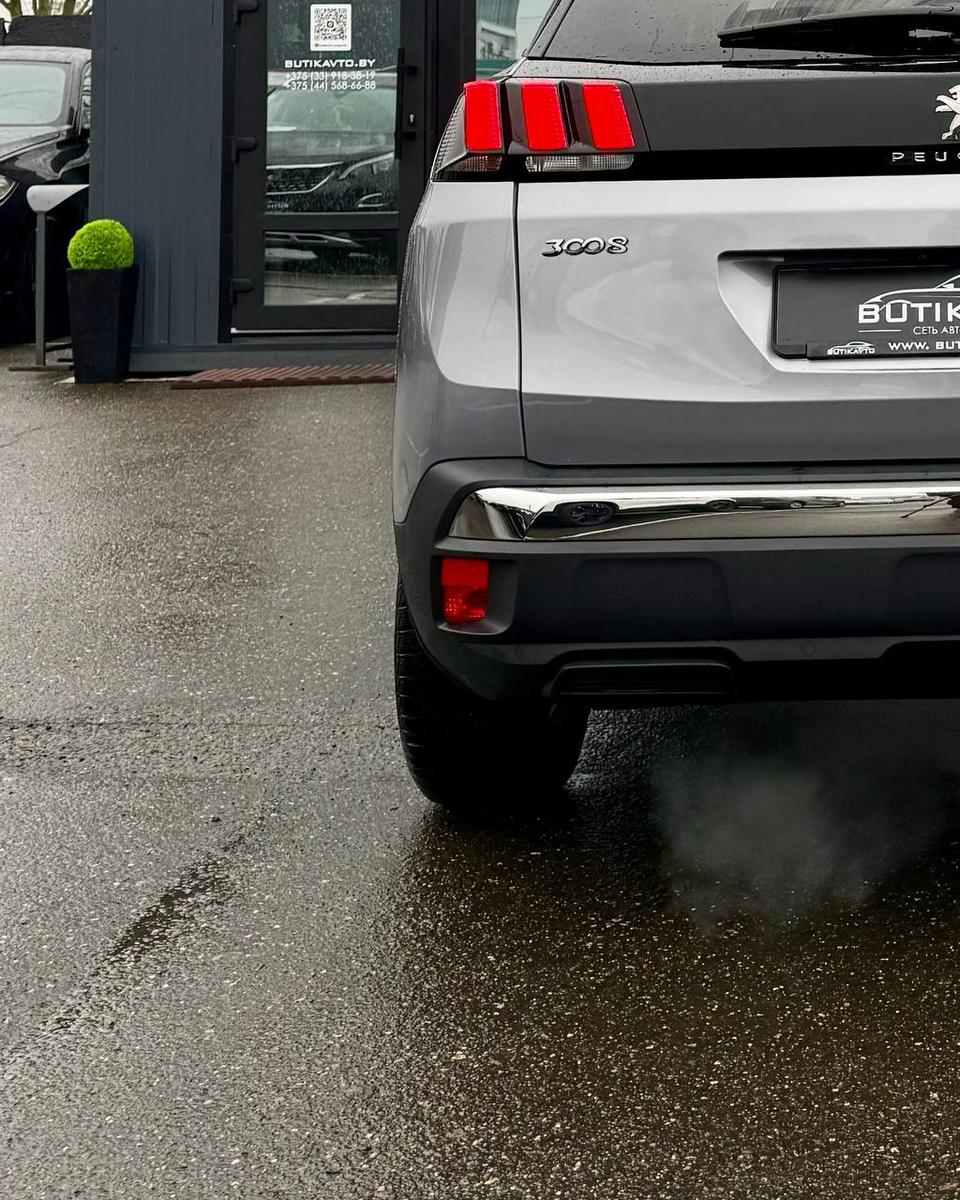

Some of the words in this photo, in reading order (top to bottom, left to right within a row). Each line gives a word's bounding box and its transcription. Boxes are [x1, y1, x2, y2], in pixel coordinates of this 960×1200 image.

[284, 59, 376, 69] BUTIKAVTO.BY
[310, 80, 328, 92] (44)
[330, 80, 376, 91] 568-66-88
[541, 236, 629, 258] 3008
[912, 326, 939, 336] СЕТЬ
